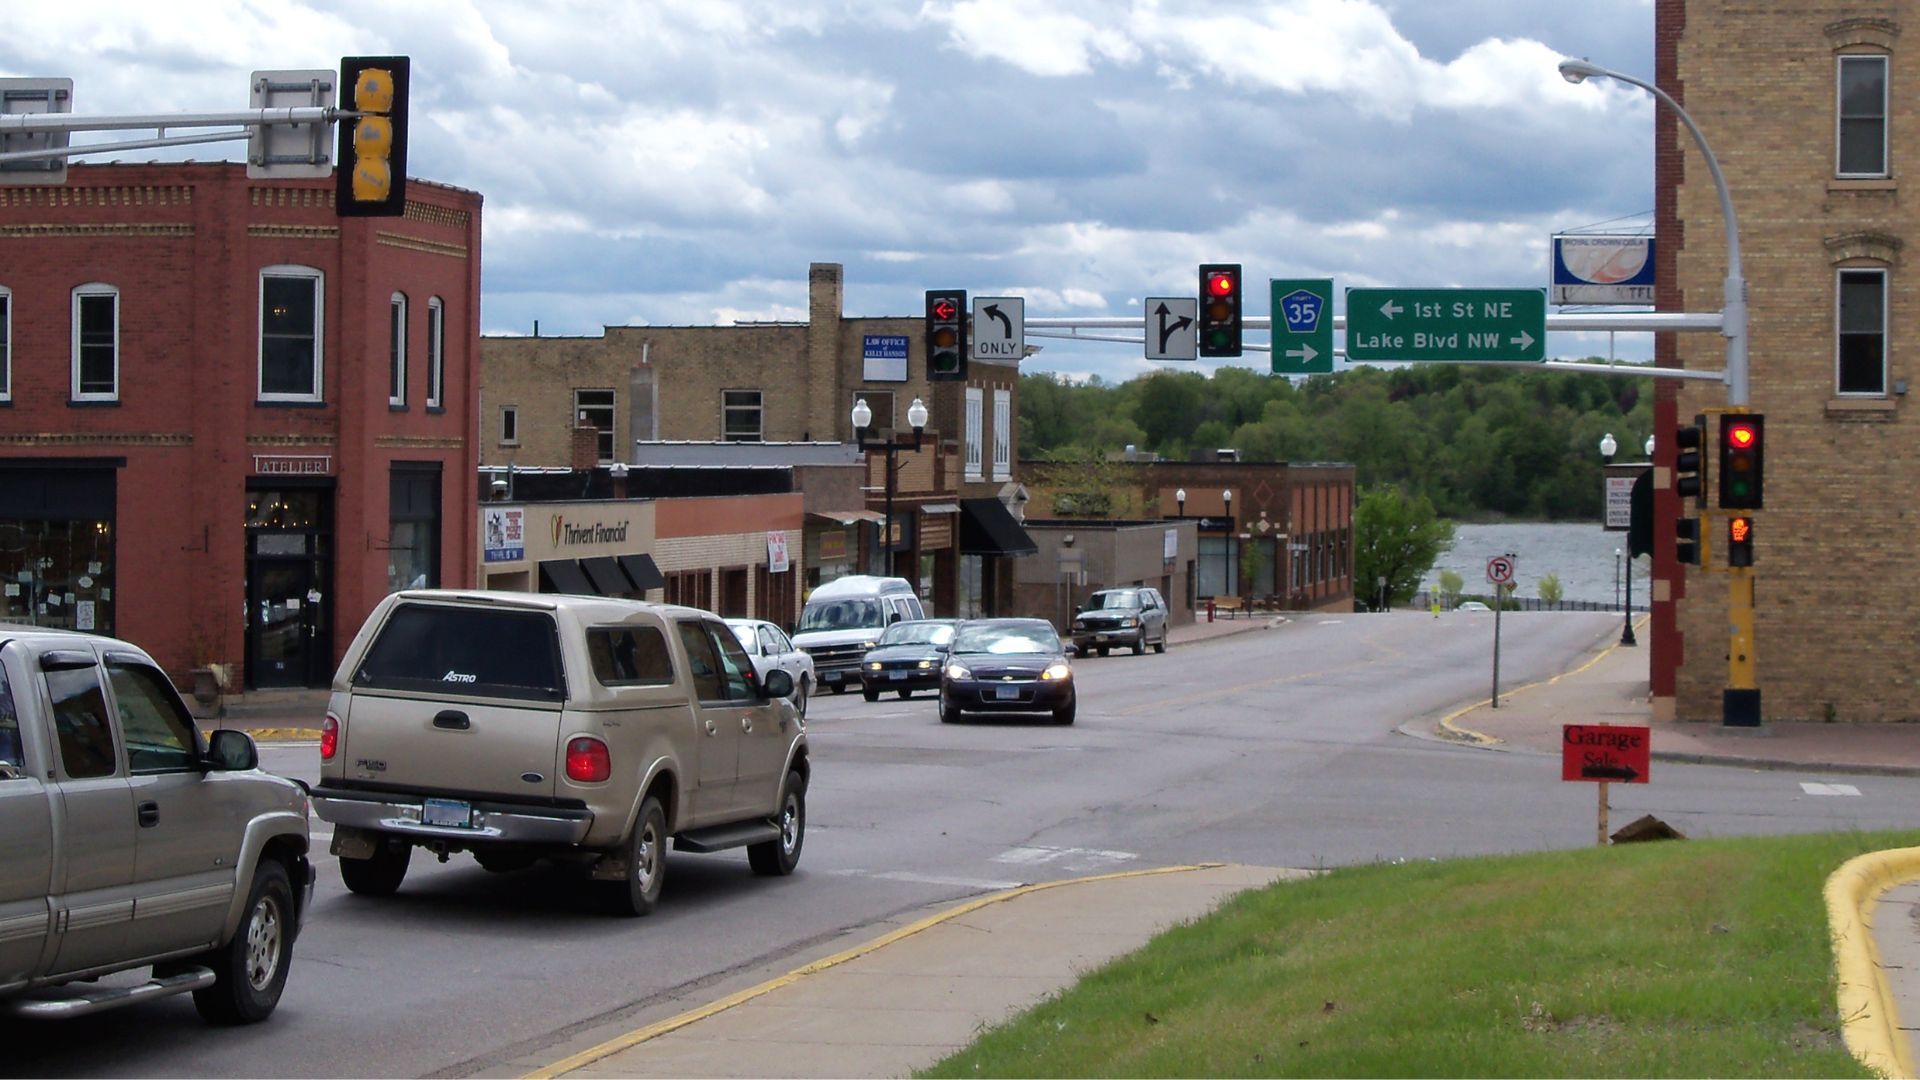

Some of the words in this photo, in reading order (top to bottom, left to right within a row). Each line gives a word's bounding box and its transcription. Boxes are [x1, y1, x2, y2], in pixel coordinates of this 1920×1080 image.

[1288, 303, 1317, 324] 35
[1414, 302, 1441, 318] 1st
[1452, 302, 1474, 318] St
[1484, 302, 1512, 318] NE
[866, 338, 880, 346] LAW
[881, 338, 905, 346] OFFICE
[980, 342, 1017, 355] ONLY
[1356, 332, 1404, 348] Lake
[1414, 332, 1458, 349] Blvd
[1468, 332, 1500, 348] NW
[262, 461, 323, 474] ATELIER
[564, 522, 594, 545] Thrivent
[595, 520, 627, 543] Financial
[1563, 725, 1642, 752] Garage
